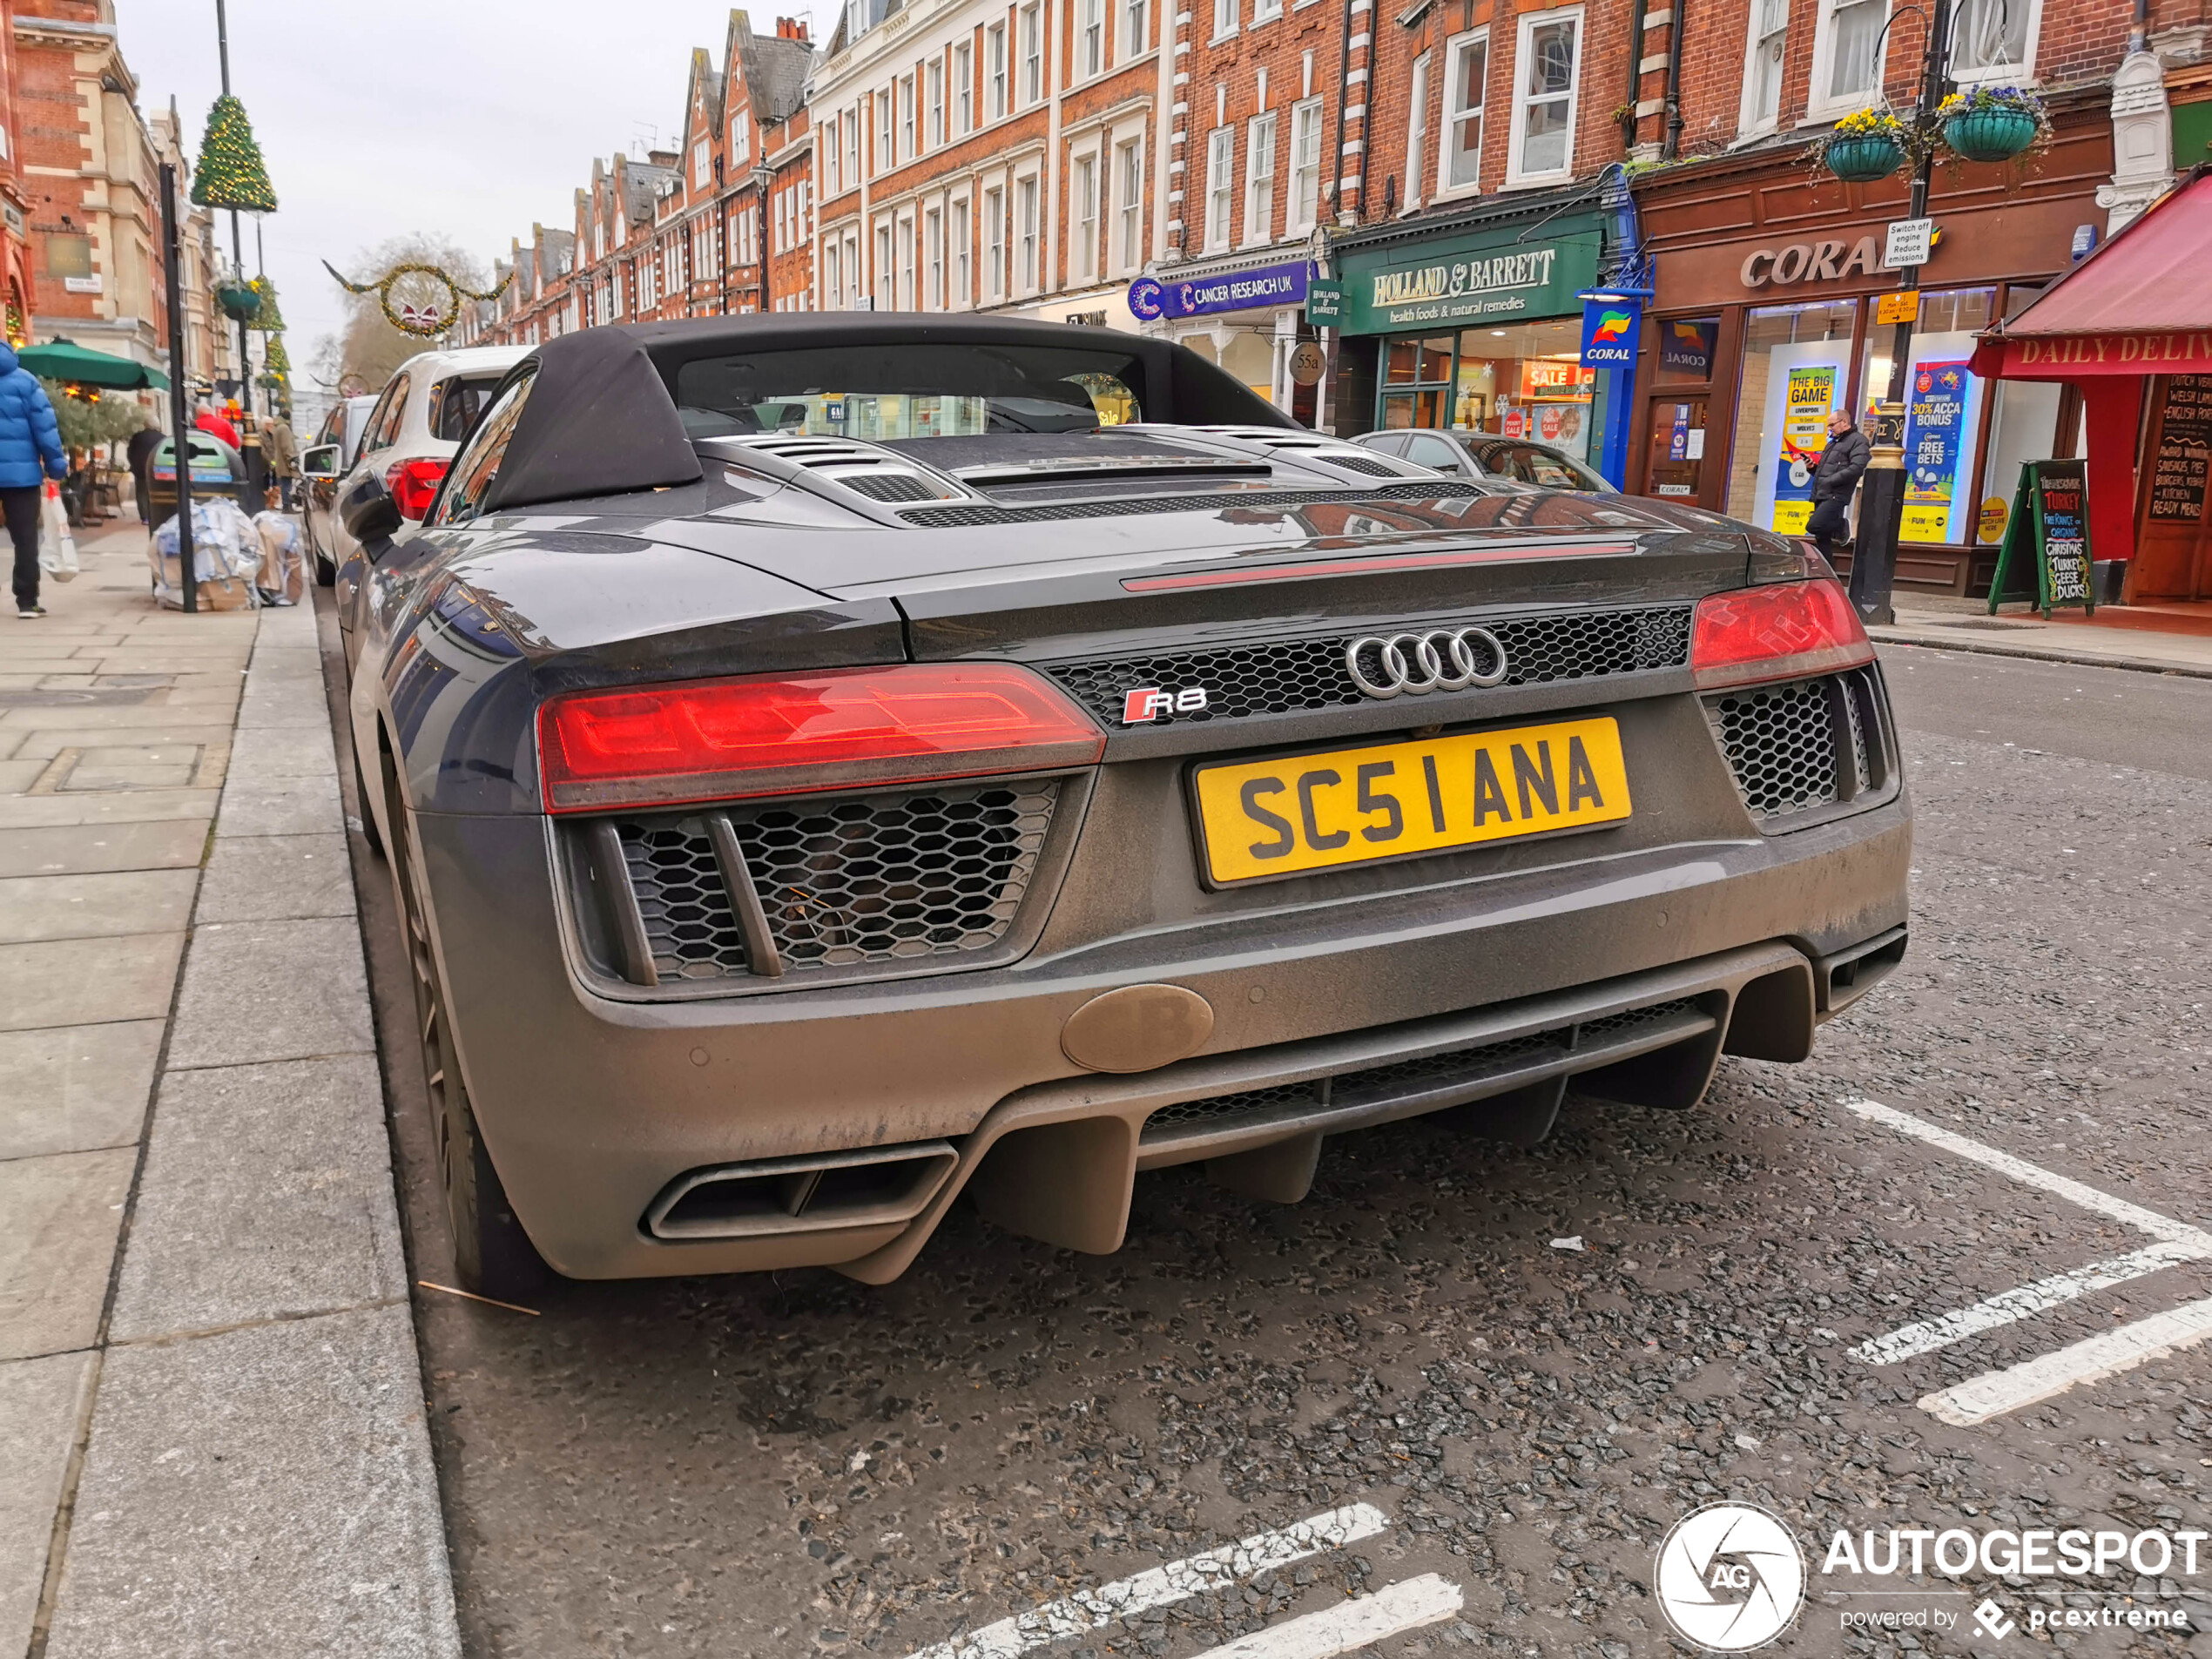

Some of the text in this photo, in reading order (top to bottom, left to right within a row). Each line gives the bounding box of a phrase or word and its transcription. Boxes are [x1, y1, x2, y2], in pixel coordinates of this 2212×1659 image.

[1891, 225, 1916, 233] Switch
[1897, 233, 1920, 242] engine
[1889, 253, 1924, 263] emissions
[1372, 249, 1555, 307] HOLLAND & BARRETT
[1195, 287, 1229, 304] CANCER
[1231, 279, 1278, 299] RESEARCH
[1278, 275, 1293, 292] UK
[1313, 289, 1340, 300] HOLLAND
[1312, 306, 1339, 315] BARRETT
[1390, 296, 1526, 323] health foods & natural remedies
[1587, 348, 1629, 360] CORAL
[2020, 338, 2112, 363] DAILY
[1298, 354, 1318, 369] 55a
[1530, 371, 1568, 386] SALE
[1792, 375, 1831, 388] THE BIG
[1791, 388, 1828, 402] GAME
[1912, 402, 1960, 415] 30% ACCA
[1917, 415, 1952, 426] BONUS
[1506, 426, 1521, 435] SALE
[1919, 442, 1946, 453] FREE
[1918, 454, 1944, 464] BETS
[2045, 491, 2080, 509] TURKEY
[2152, 500, 2179, 515] READY
[2051, 528, 2078, 538] ORGANIC
[2046, 543, 2082, 556] CHRISTMAS
[2052, 556, 2080, 571] TURKEY
[2055, 571, 2079, 585] GEESE
[2057, 584, 2085, 598] DUCKS
[1143, 687, 1207, 716] R8
[1473, 735, 1605, 827] ANA
